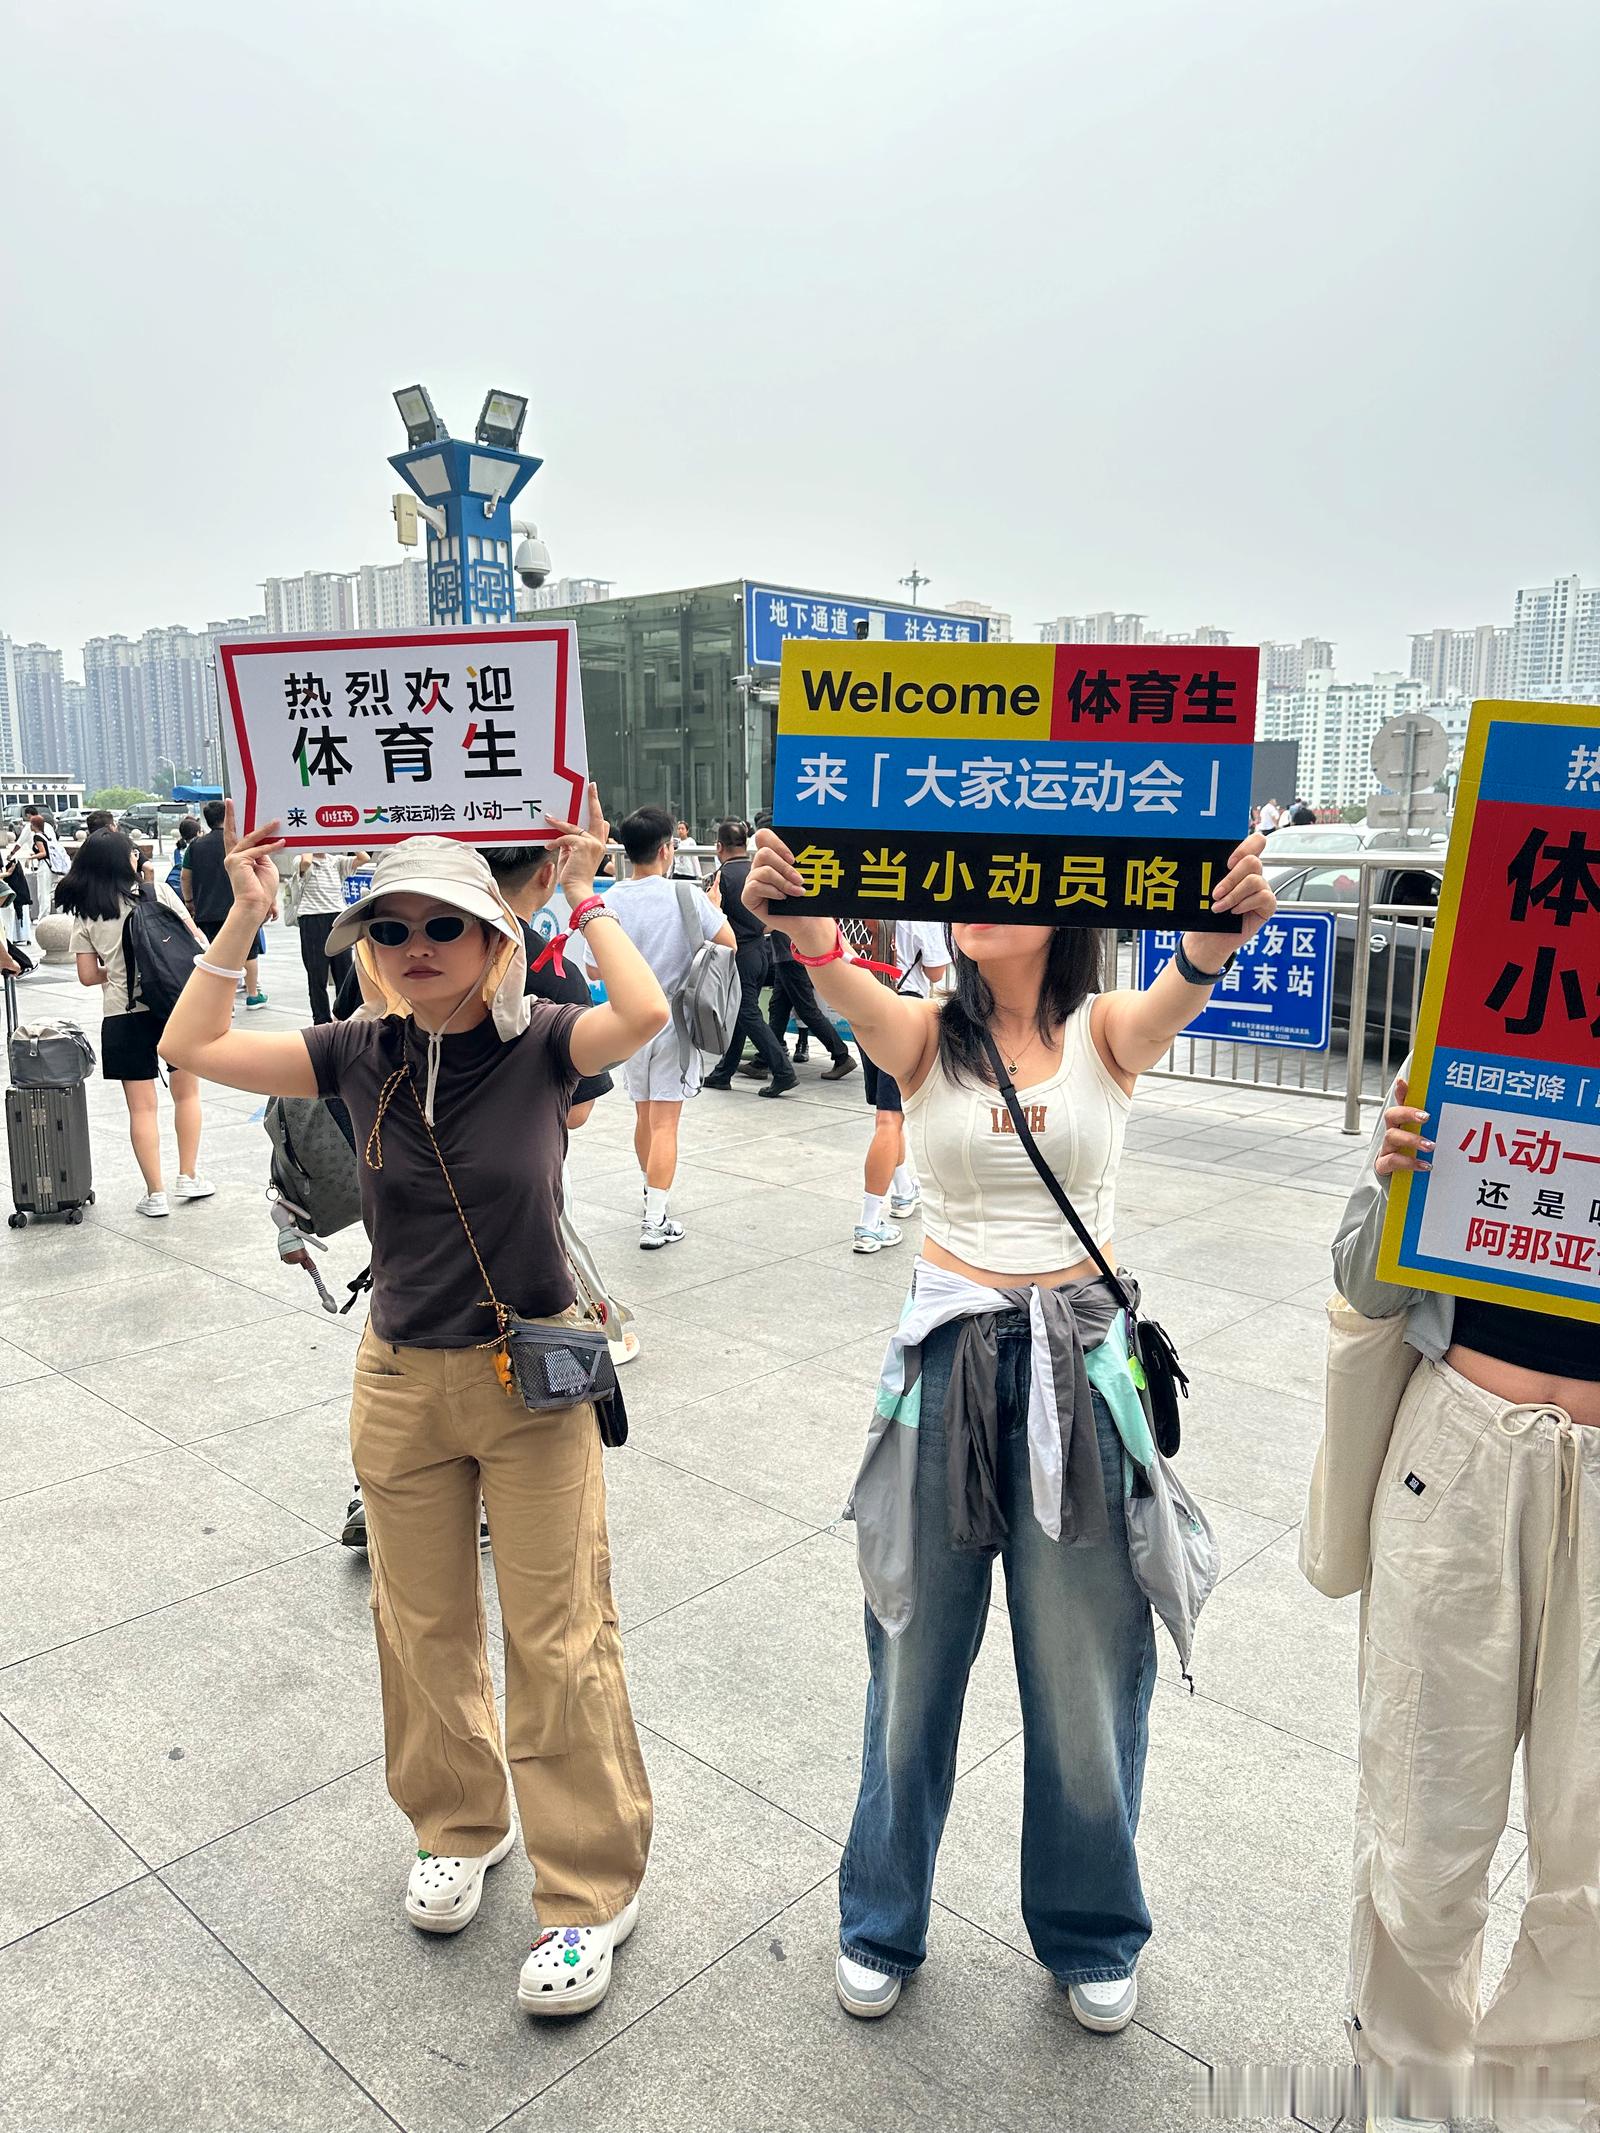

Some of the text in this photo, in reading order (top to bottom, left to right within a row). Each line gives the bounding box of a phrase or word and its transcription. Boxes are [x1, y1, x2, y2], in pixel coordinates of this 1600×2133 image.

[770, 598, 971, 643] 地下通道 社会车辆
[284, 664, 515, 720] 热烈欢迎
[801, 668, 1238, 724] Welcome 体育生
[292, 719, 523, 787] 体育生
[287, 808, 308, 828] 来
[462, 799, 542, 822] 小动一下
[1483, 946, 1600, 1038] 小
[1476, 1179, 1600, 1226] 还是
